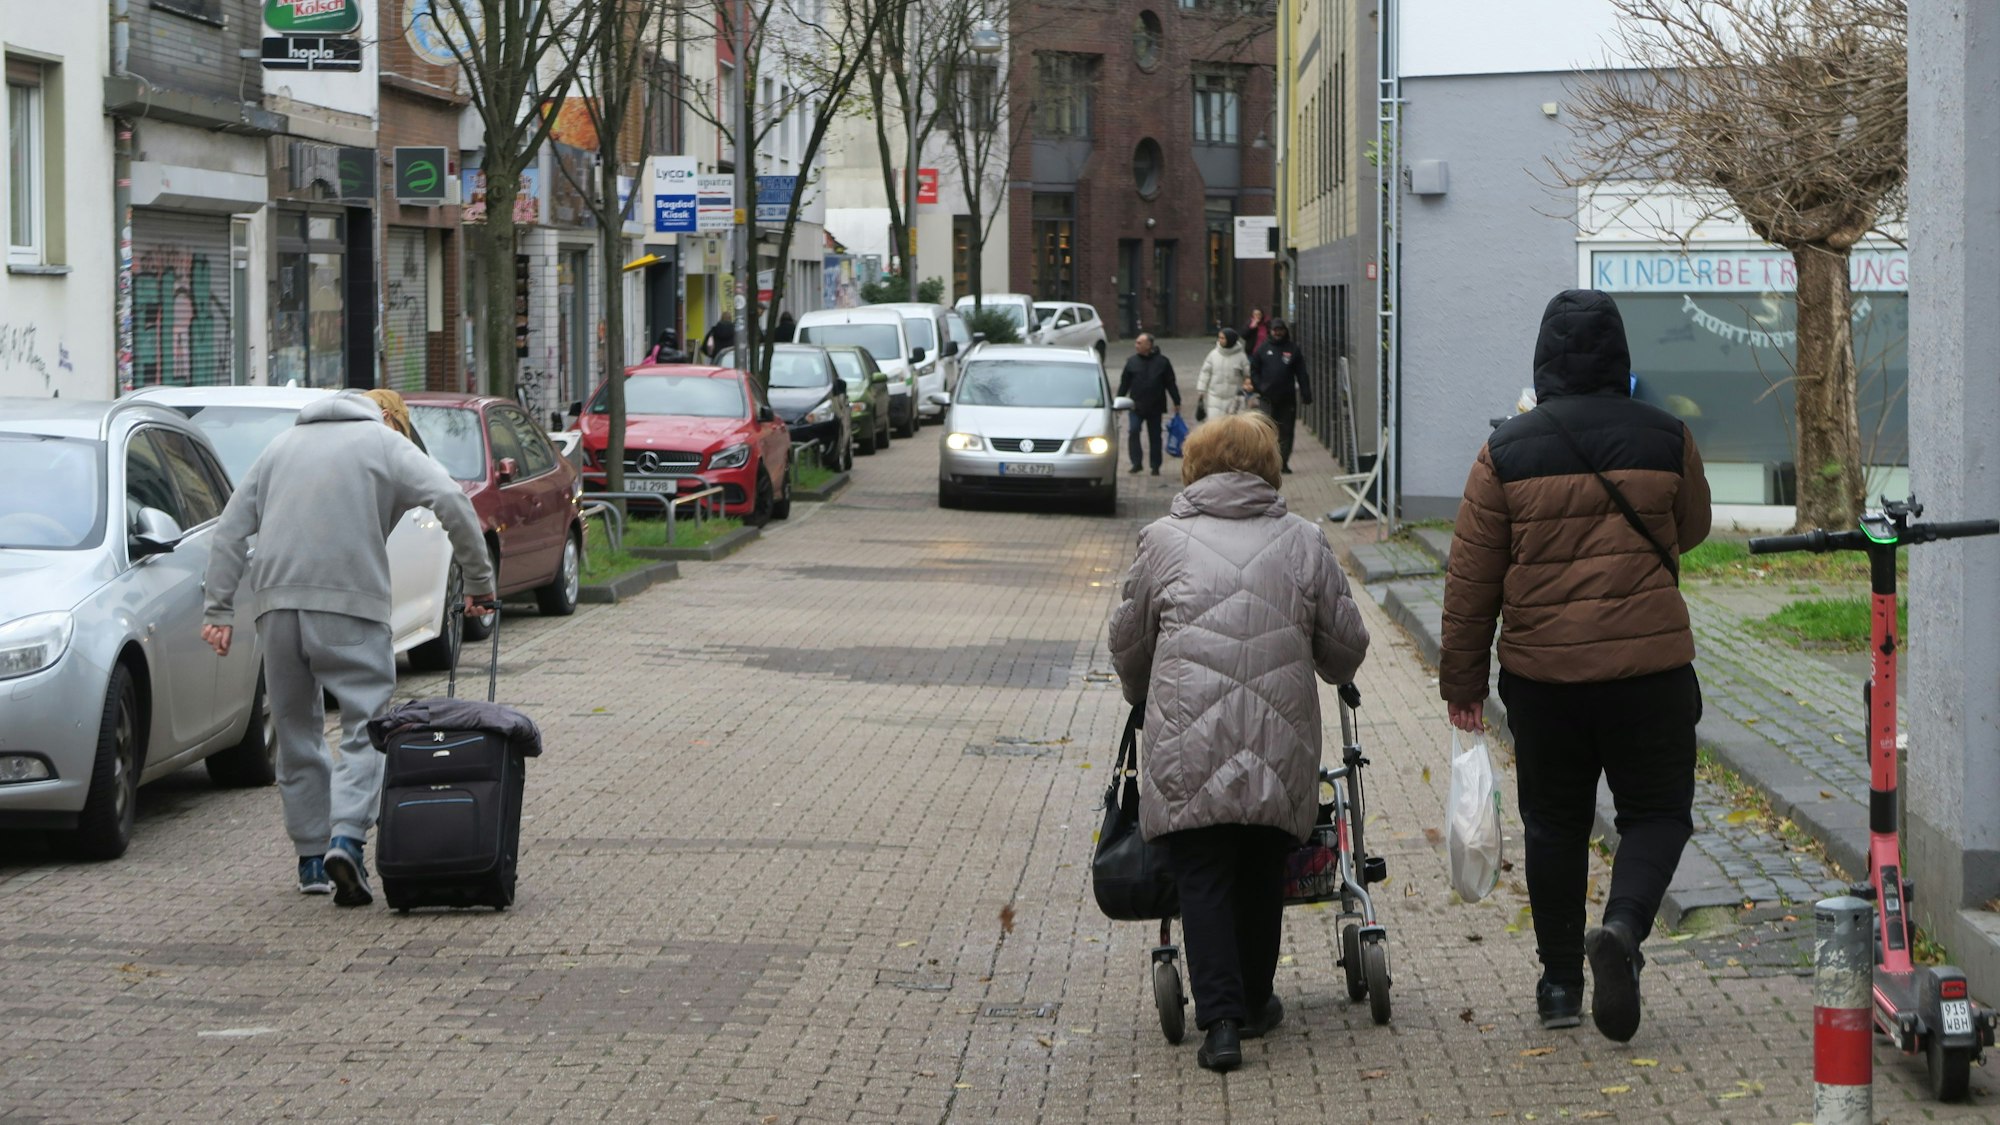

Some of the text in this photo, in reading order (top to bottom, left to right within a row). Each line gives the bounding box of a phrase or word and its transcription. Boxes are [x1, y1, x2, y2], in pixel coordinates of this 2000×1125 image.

[295, 0, 345, 16] Kölsch
[288, 37, 335, 70] hopla
[656, 168, 685, 180] Lyca
[657, 200, 695, 210] Bagdad
[662, 211, 690, 219] Kiosk
[1598, 258, 1907, 286] KINDERBETRUNG
[1945, 1002, 1967, 1016] 915
[1946, 1017, 1969, 1031] WBH
